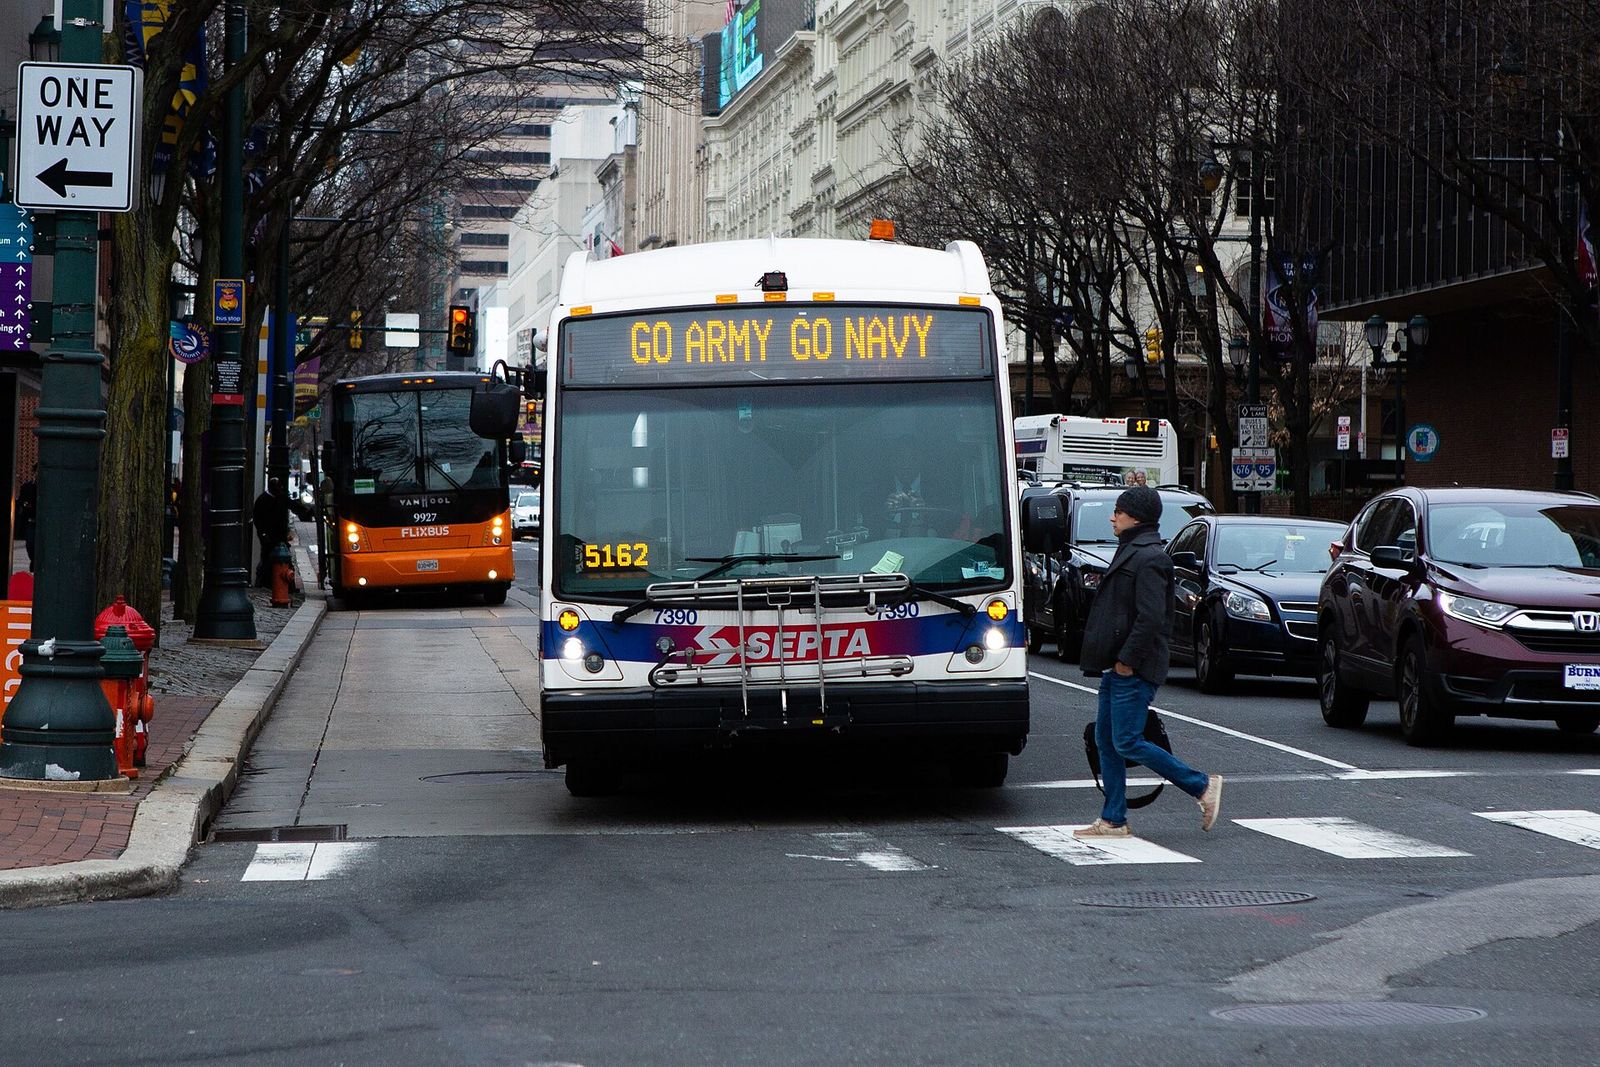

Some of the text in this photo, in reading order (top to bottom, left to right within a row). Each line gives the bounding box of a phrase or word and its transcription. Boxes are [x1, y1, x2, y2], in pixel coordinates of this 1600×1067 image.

[40, 77, 114, 109] ONE
[36, 115, 116, 148] WAY
[0, 324, 14, 334] ing
[630, 315, 933, 364] GO ARMY GO NAVY
[1136, 420, 1150, 432] 17
[1236, 465, 1250, 475] 676
[1259, 465, 1271, 475] 95
[399, 498, 420, 506] VAN
[413, 512, 437, 523] 9927
[585, 542, 649, 569] 5162
[653, 608, 697, 625] 7390
[876, 602, 919, 621] 7390
[745, 628, 871, 660] SEPTA
